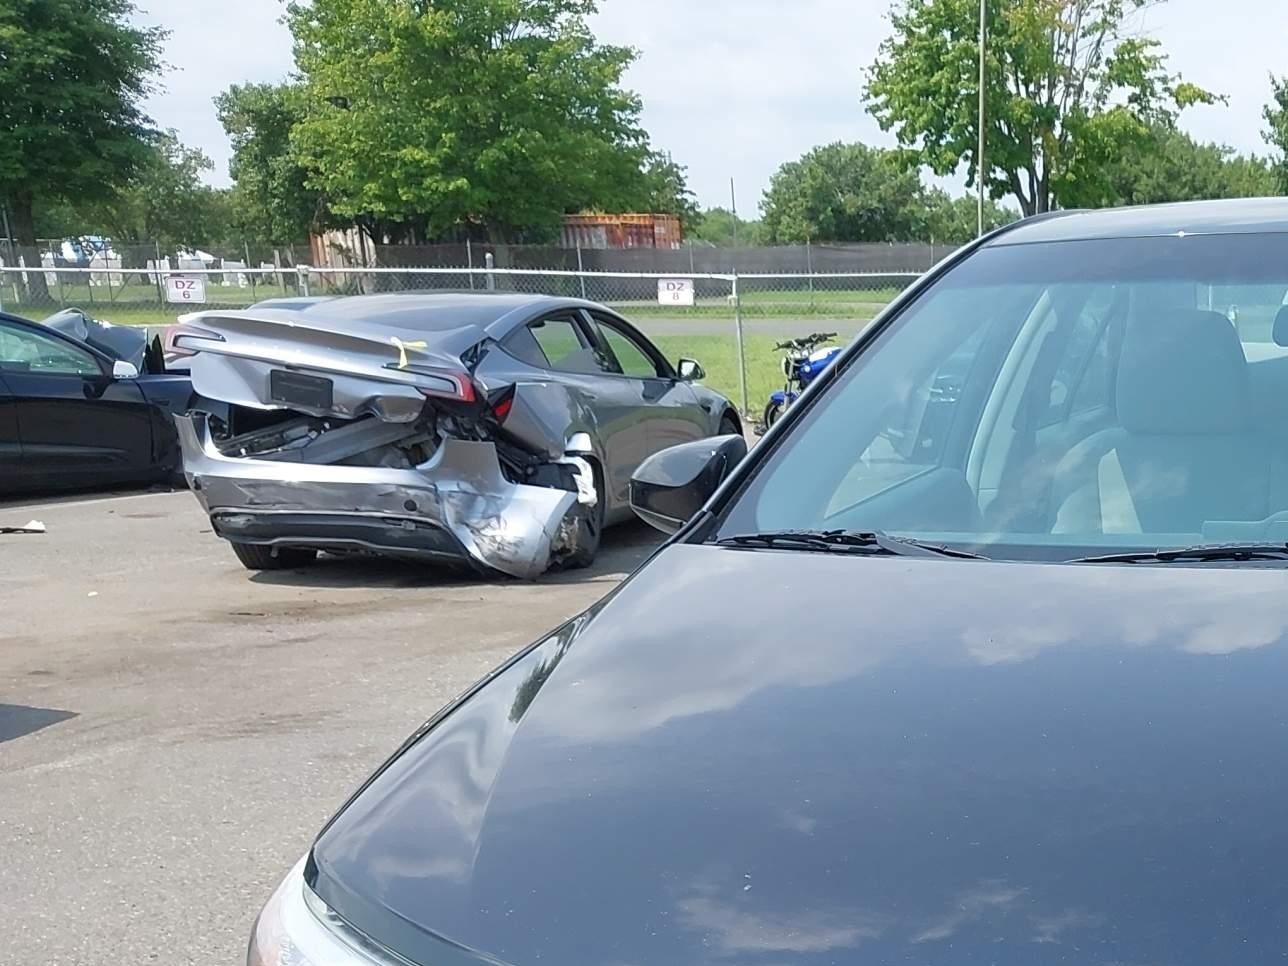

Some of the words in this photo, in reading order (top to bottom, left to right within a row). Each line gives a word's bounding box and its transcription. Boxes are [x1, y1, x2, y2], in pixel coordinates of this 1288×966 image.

[175, 280, 196, 290] DZ
[666, 282, 685, 291] DZ
[182, 290, 191, 299] 6
[672, 291, 680, 301] 8
